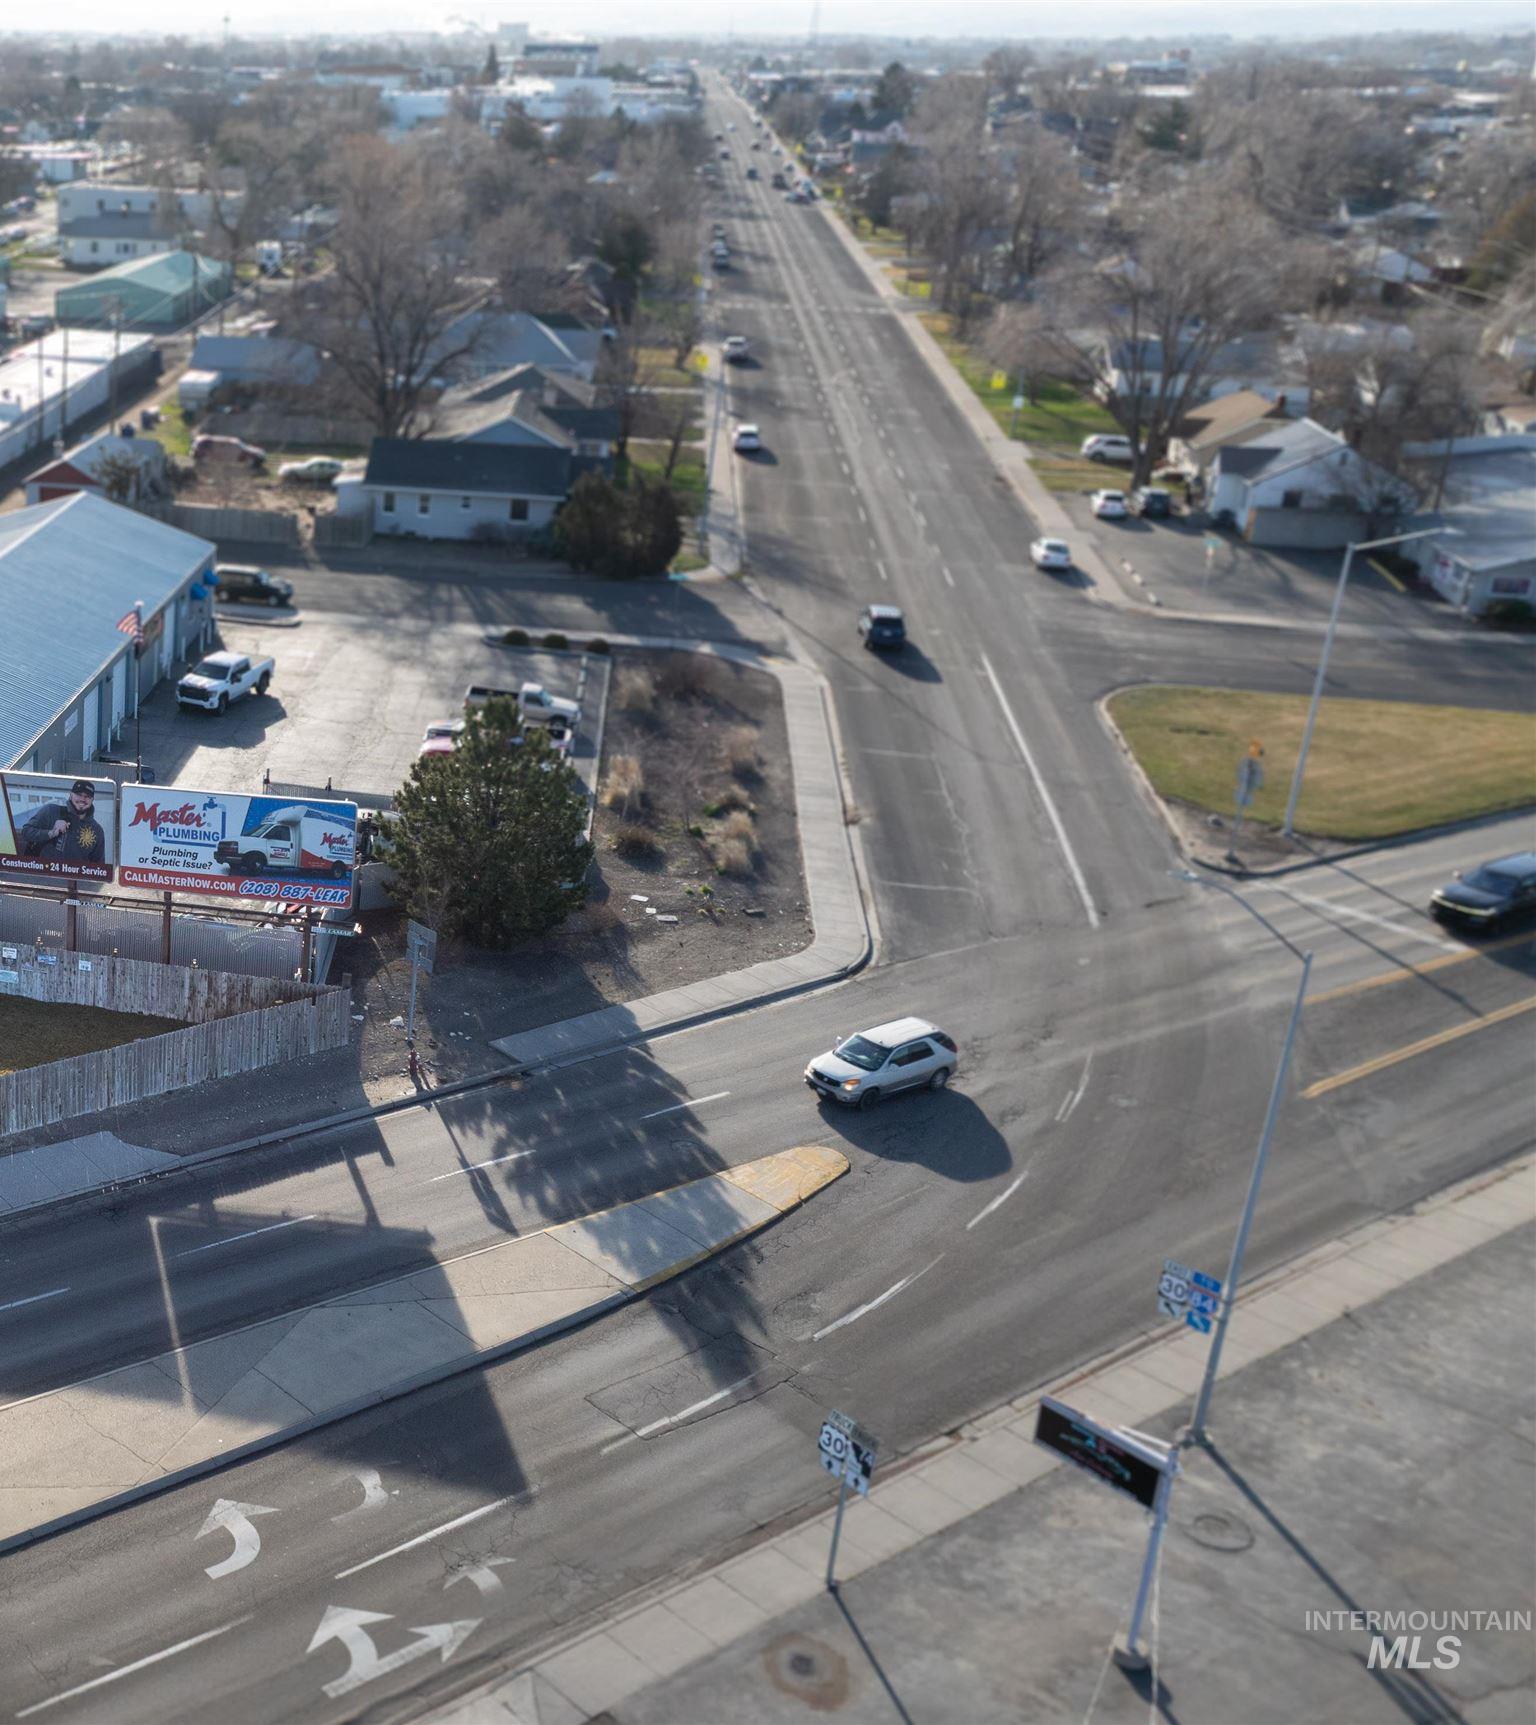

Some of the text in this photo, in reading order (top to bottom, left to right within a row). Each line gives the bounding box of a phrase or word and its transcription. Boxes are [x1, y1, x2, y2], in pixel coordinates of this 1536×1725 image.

[128, 802, 207, 832] Master
[158, 827, 220, 842] PLUMBING
[150, 856, 181, 867] Septic
[182, 860, 213, 870] Issue?
[152, 846, 199, 860] Plumbing
[1, 857, 44, 870] Construction
[50, 862, 60, 872] 24
[62, 864, 80, 874] Hour
[81, 865, 107, 877] Service
[239, 880, 280, 897] (208)
[280, 885, 350, 903] 887-LEAK
[1162, 1278, 1185, 1299] 30
[822, 1430, 844, 1454] 30
